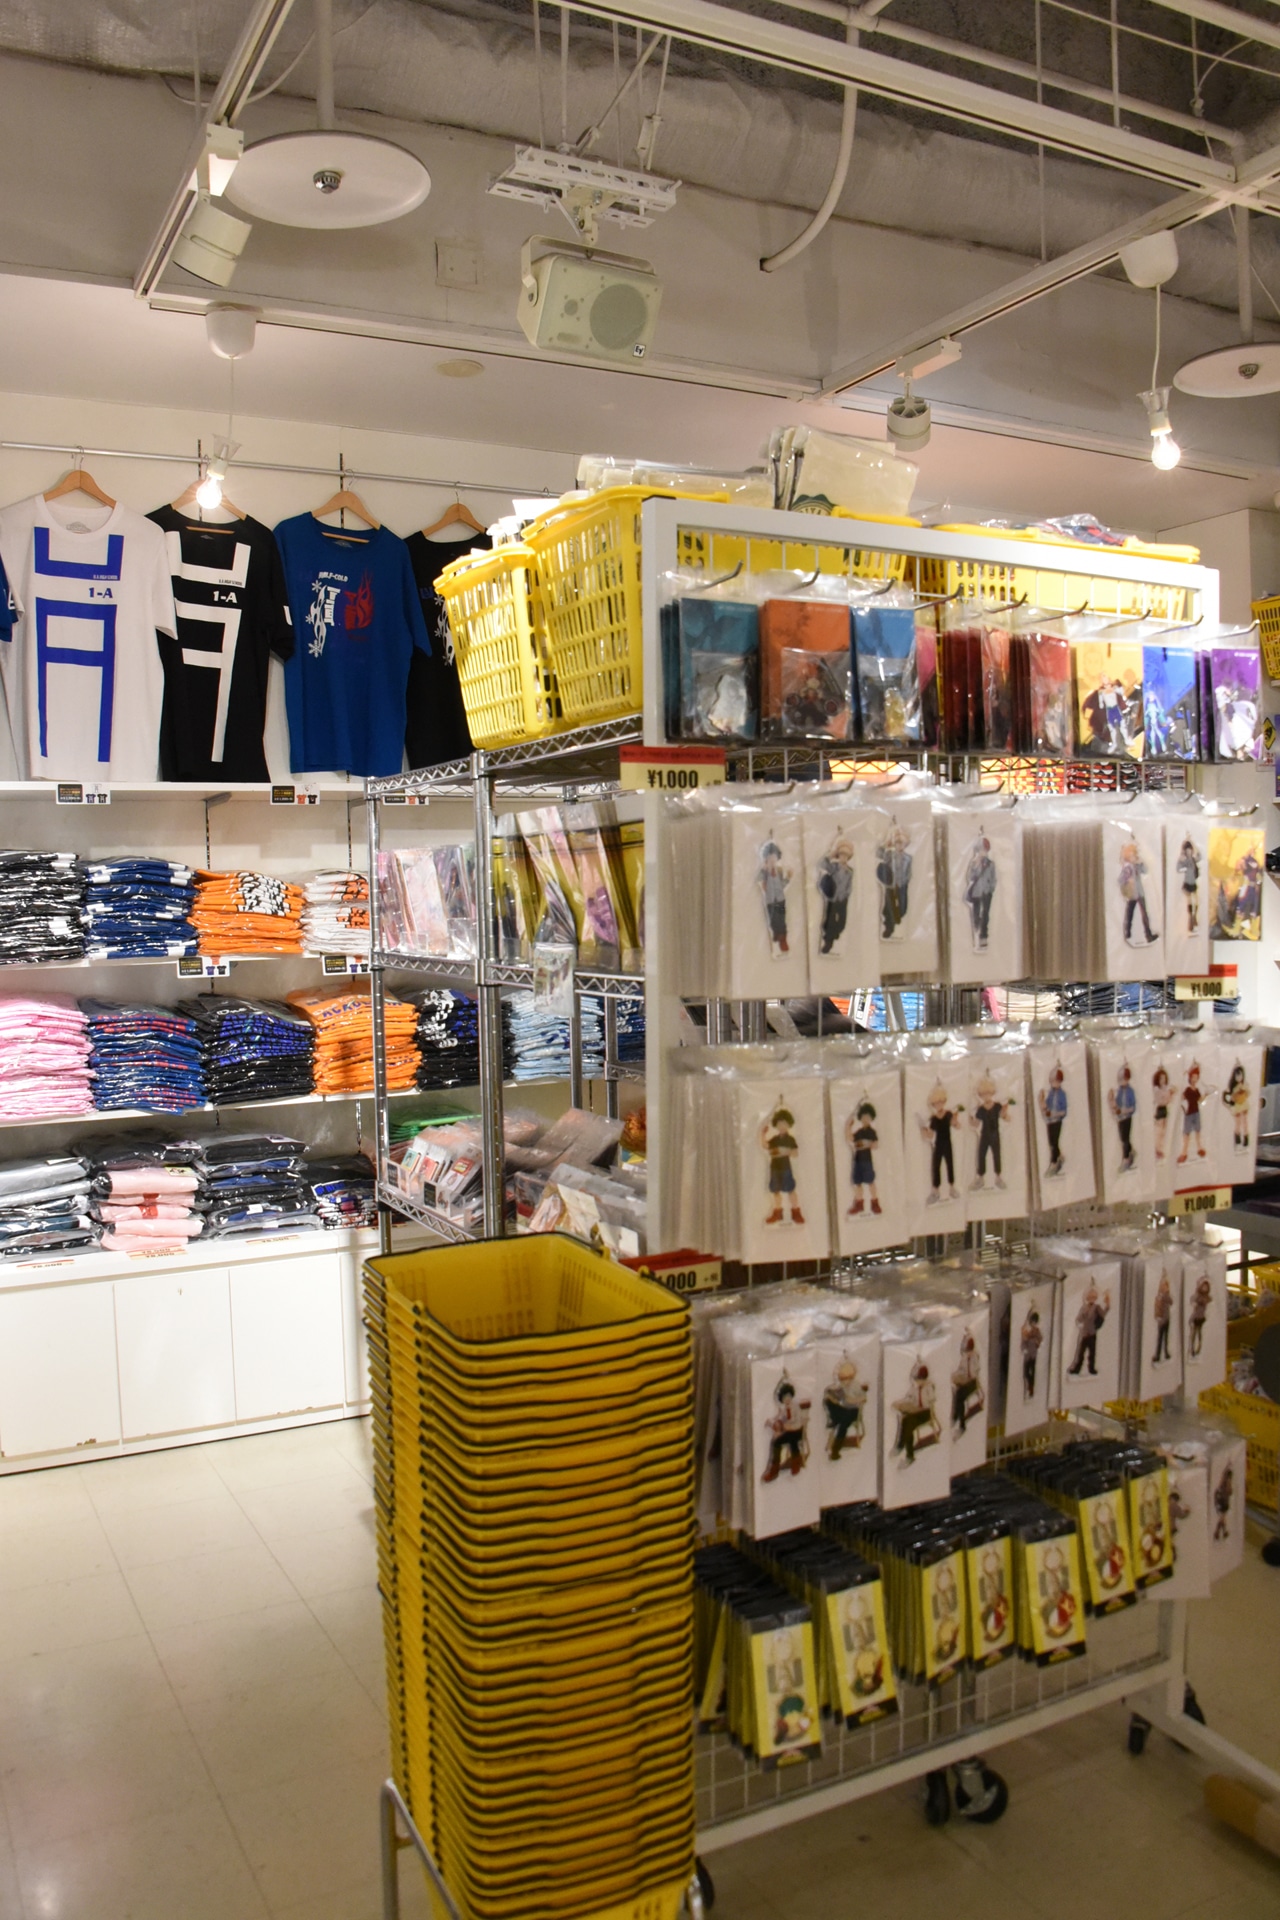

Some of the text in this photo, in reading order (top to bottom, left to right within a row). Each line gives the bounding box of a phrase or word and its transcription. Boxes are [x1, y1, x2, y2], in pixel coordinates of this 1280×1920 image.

[88, 587, 113, 599] 1-A
[213, 590, 238, 603] 1-A
[647, 769, 699, 790] ¥1,000
[1190, 982, 1222, 998] ¥1,000
[1184, 1194, 1216, 1212] ¥1,000
